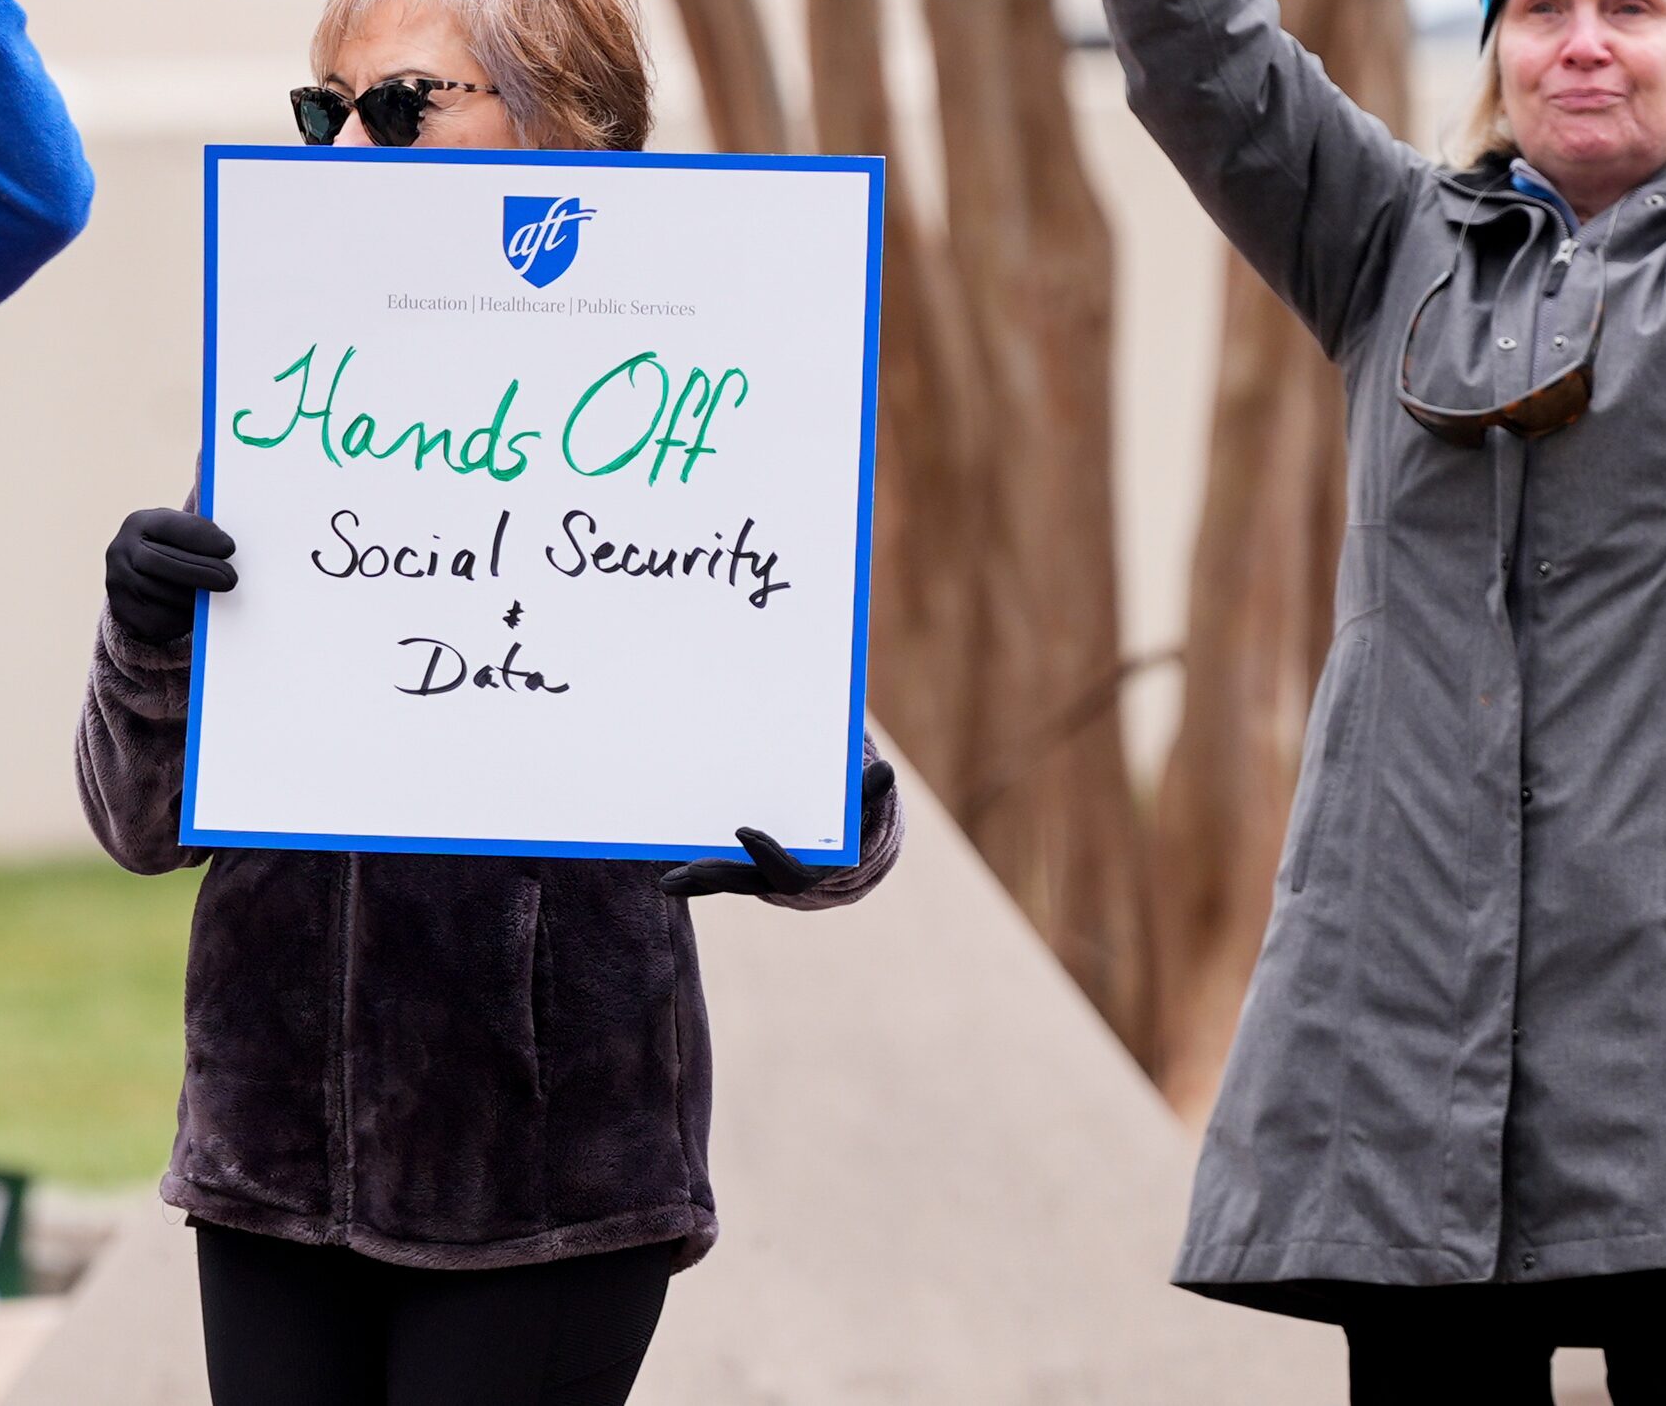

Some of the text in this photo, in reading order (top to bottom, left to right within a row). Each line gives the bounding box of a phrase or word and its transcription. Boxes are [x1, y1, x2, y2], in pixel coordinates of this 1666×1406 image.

[508, 196, 598, 276] aft
[387, 293, 696, 316] Education Healthcare Public Services
[232, 343, 749, 487] Hands Off
[311, 509, 791, 609] Social Security
[395, 637, 570, 696] Data
